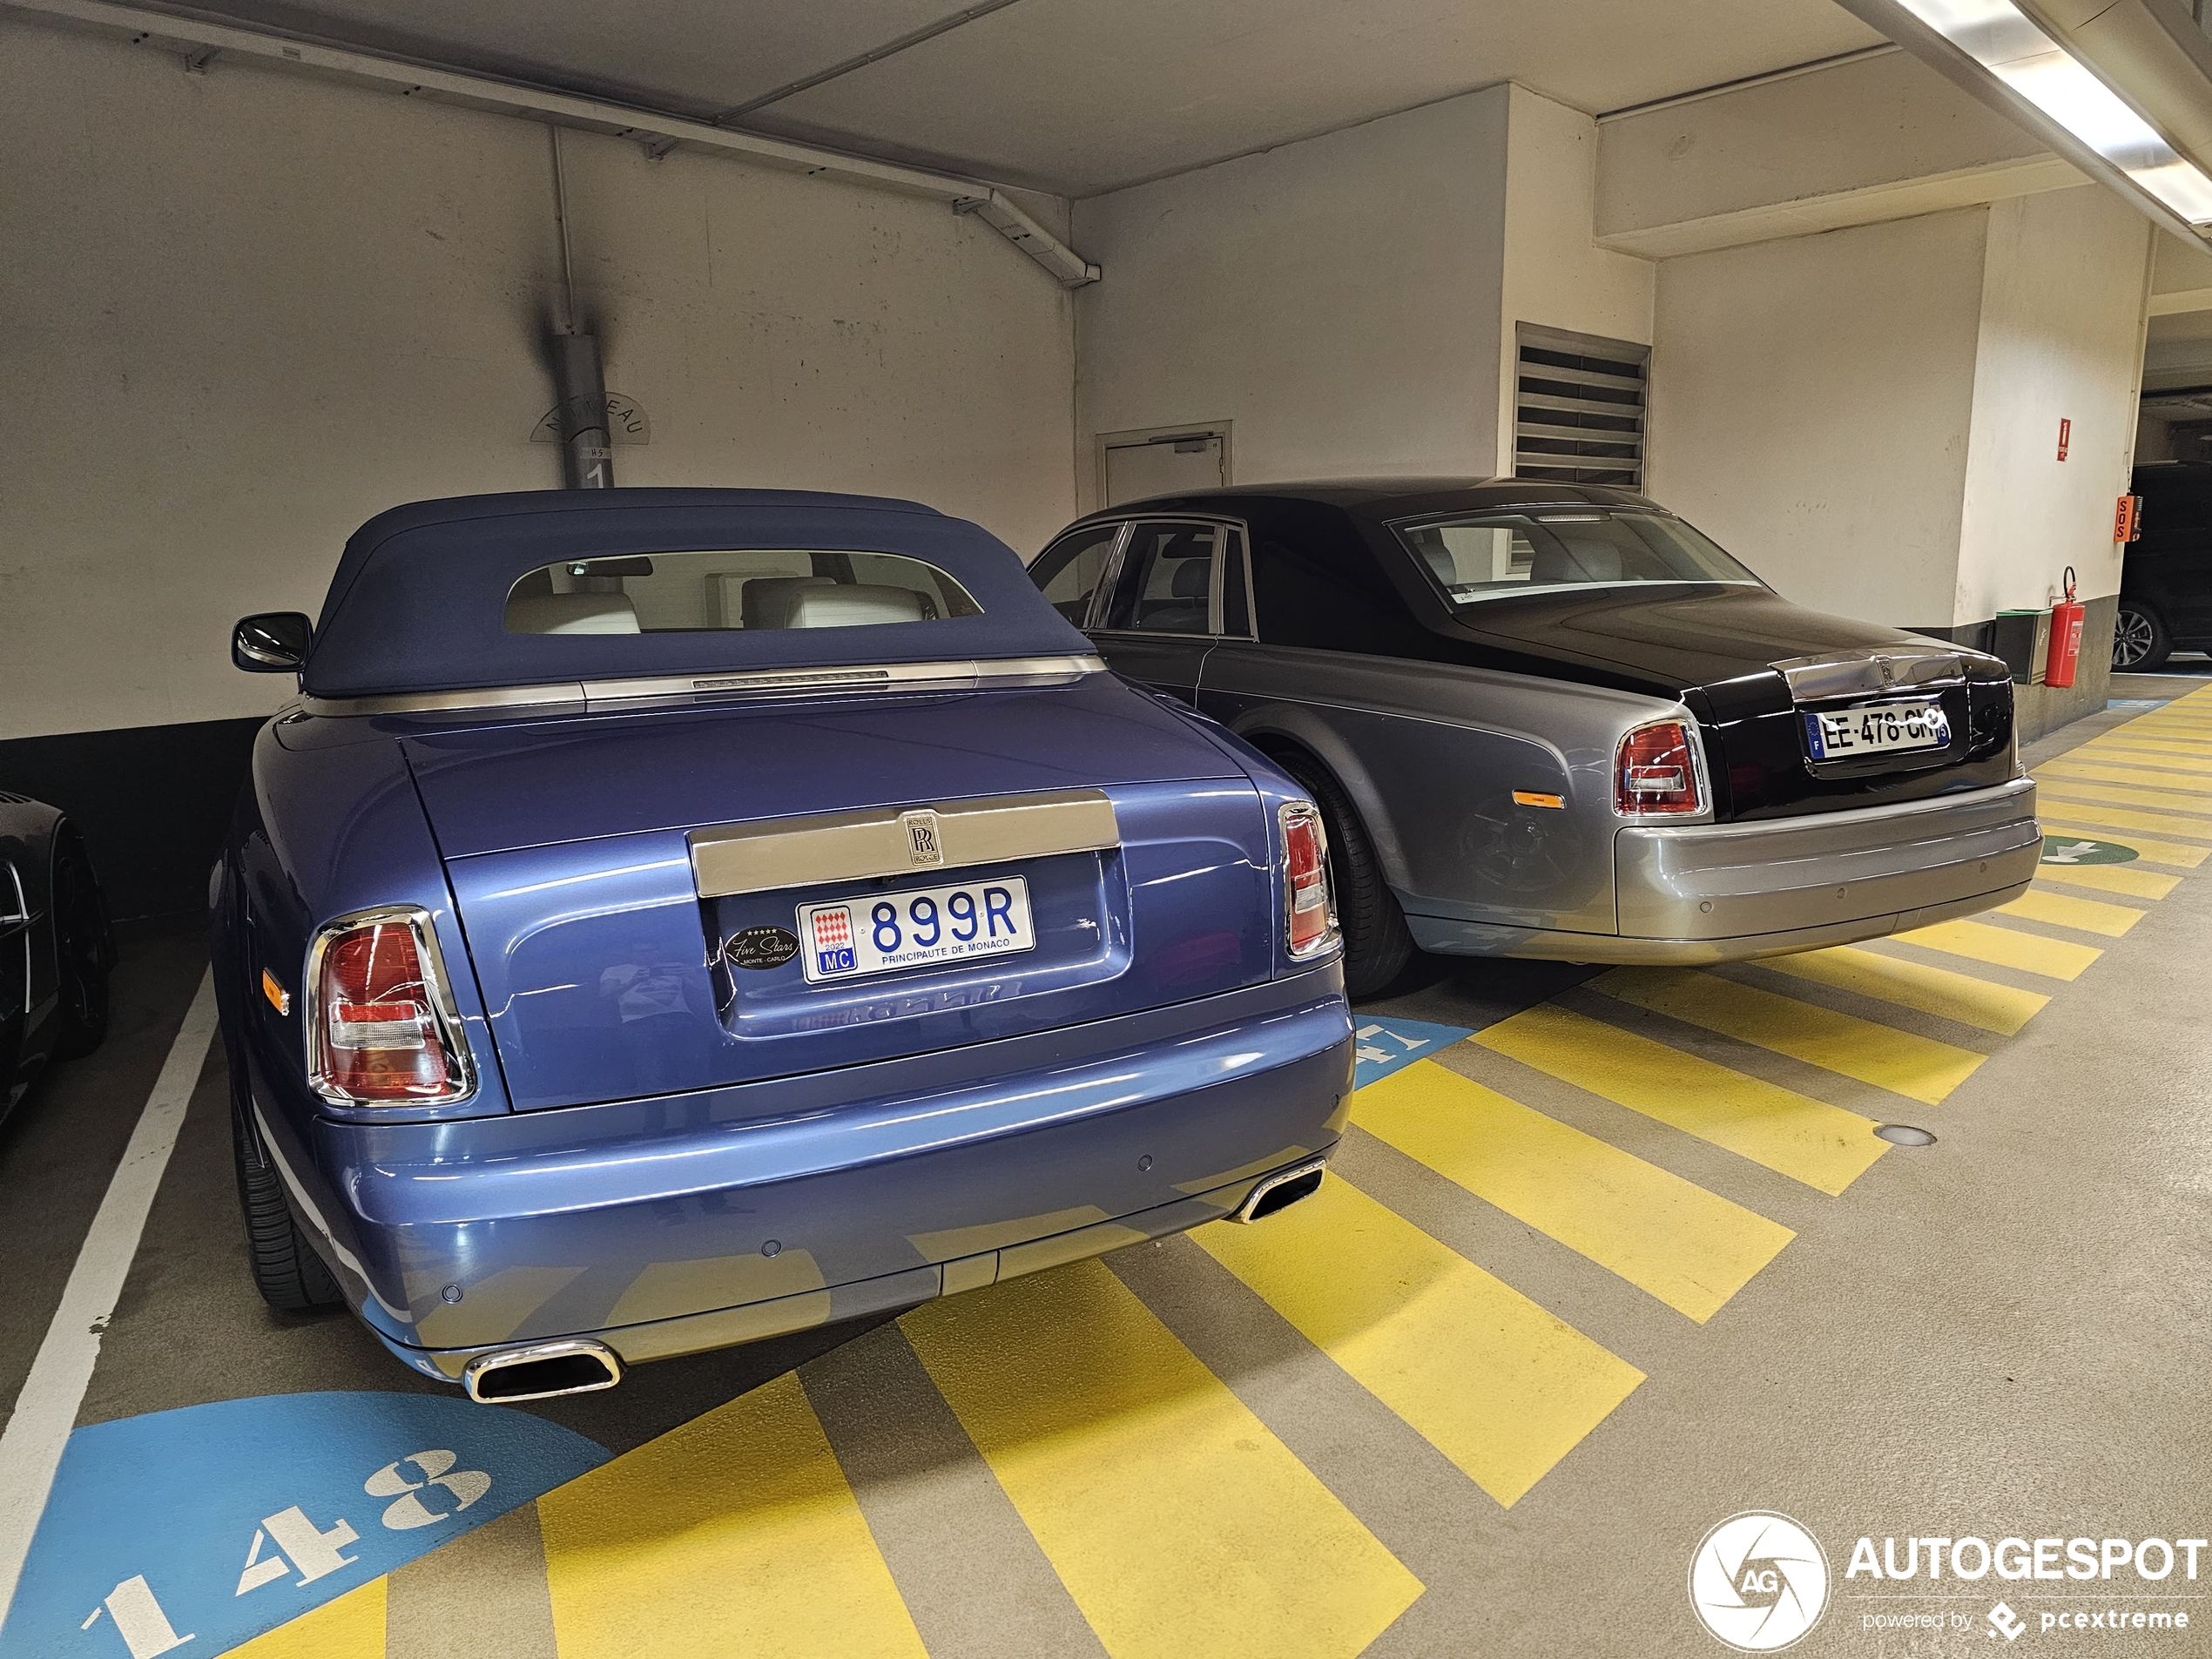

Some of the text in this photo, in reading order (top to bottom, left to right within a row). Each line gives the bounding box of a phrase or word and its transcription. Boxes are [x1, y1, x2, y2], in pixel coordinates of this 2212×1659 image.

[587, 463, 604, 489] 1
[2117, 501, 2128, 537] SOS
[1814, 741, 1819, 750] F
[915, 853, 938, 862] ROYCE
[872, 887, 1016, 952] 899R
[732, 935, 793, 957] Five Stars
[882, 938, 1010, 965] PRINCIPAUTE DE MONACO
[824, 950, 850, 969] MC
[81, 1449, 492, 1659] 148
